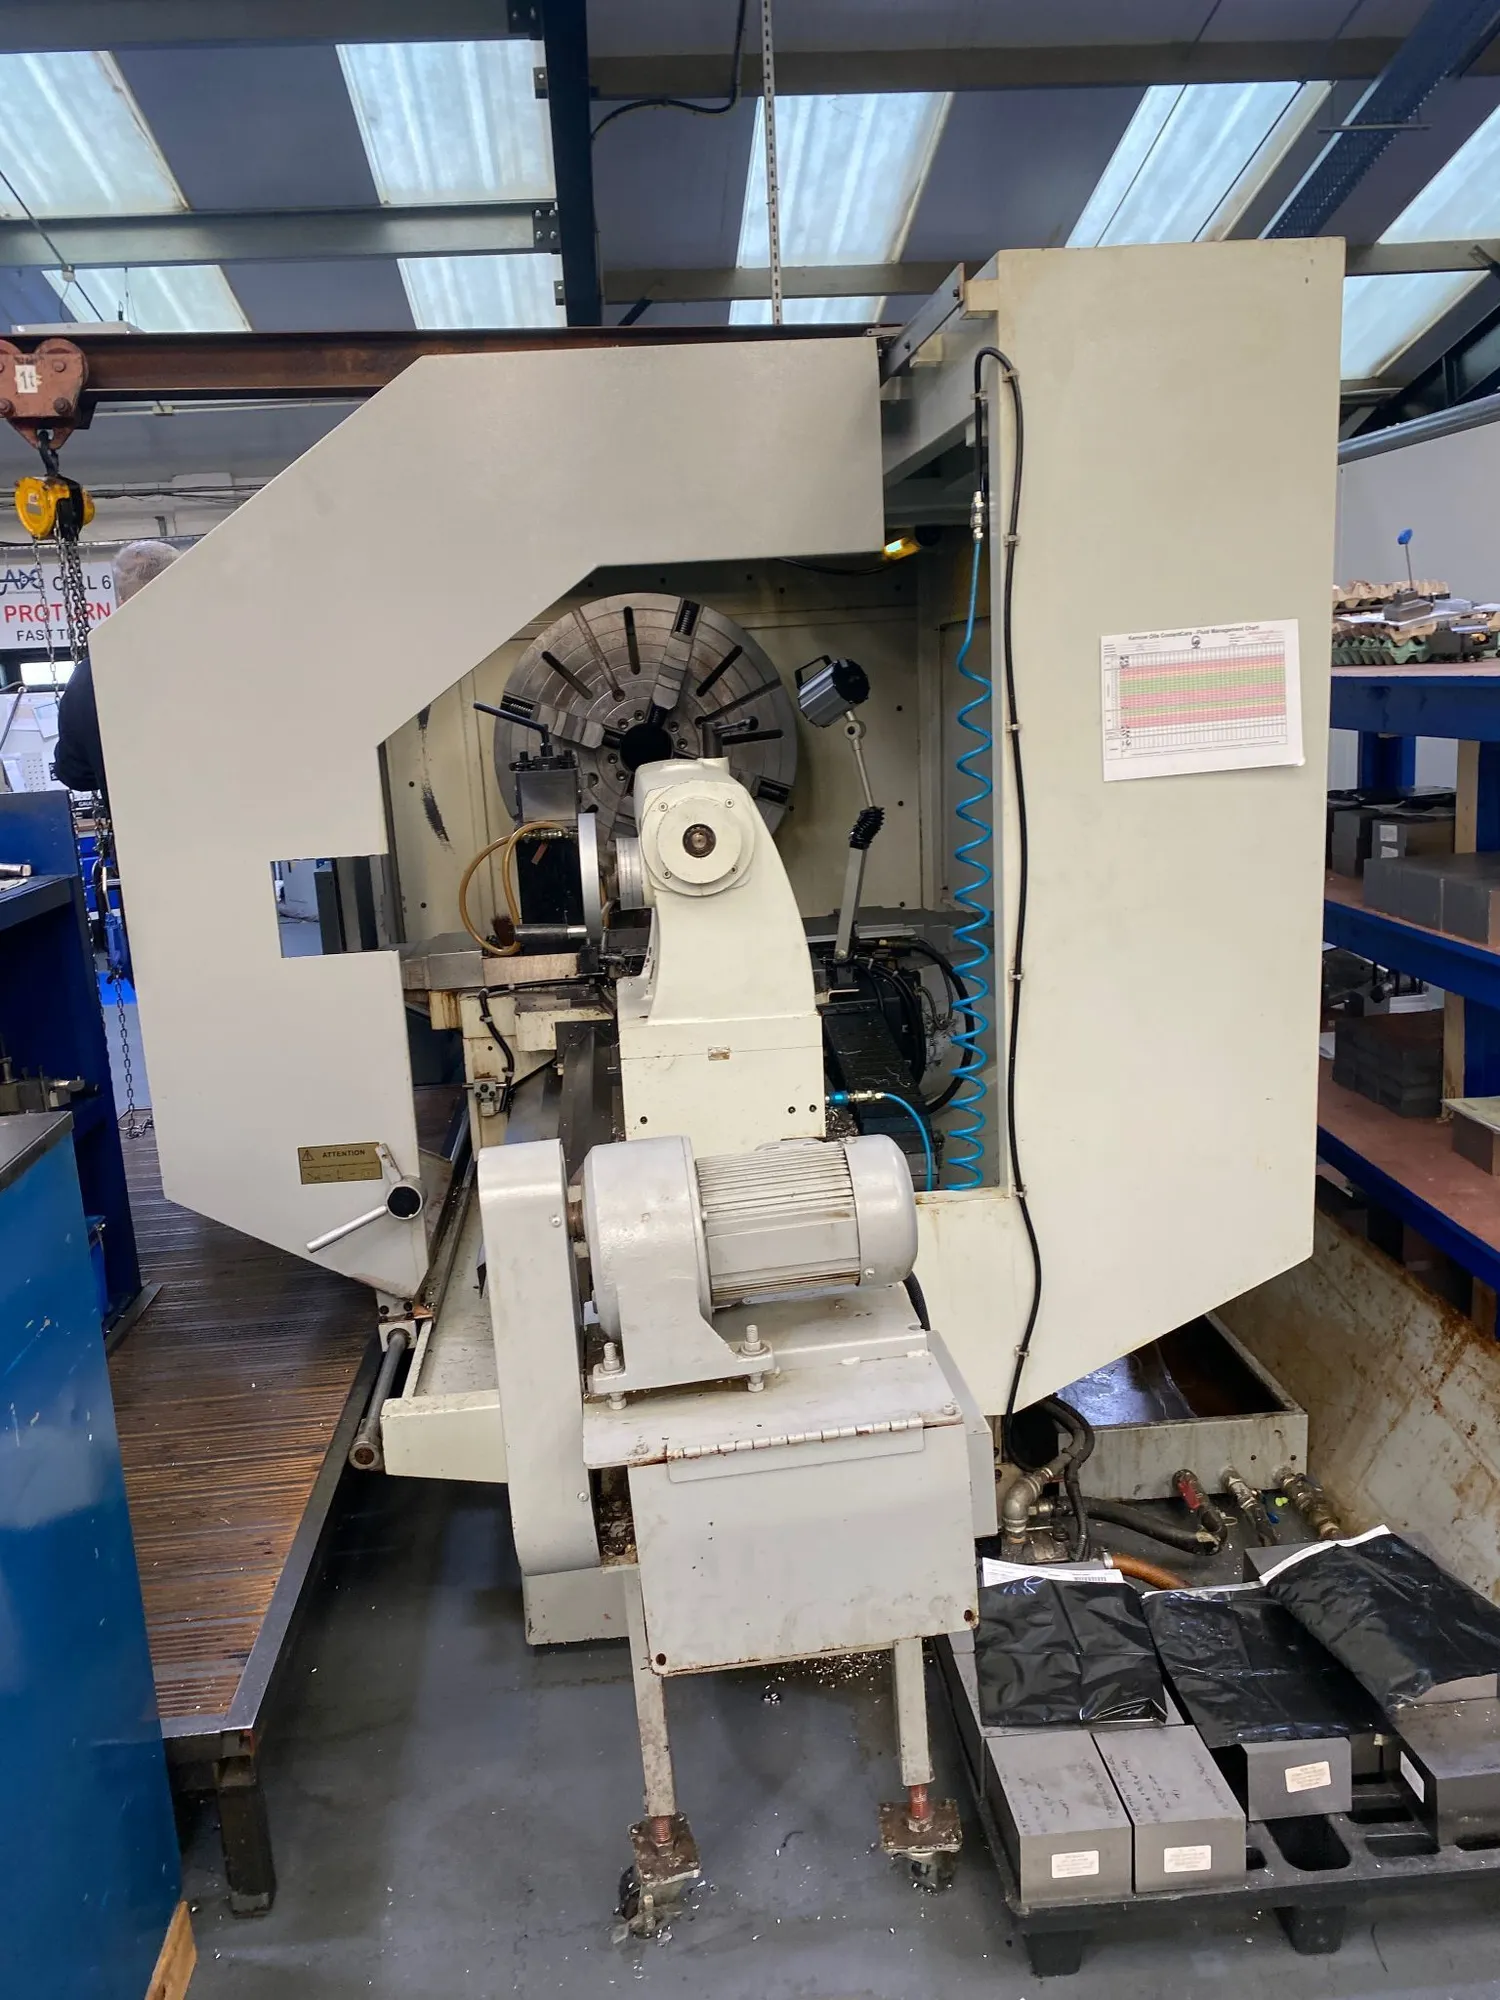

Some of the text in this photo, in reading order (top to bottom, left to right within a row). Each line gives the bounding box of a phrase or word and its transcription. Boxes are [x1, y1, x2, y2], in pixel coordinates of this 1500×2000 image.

[53, 576, 97, 590] CL
[102, 575, 111, 589] 6
[4, 602, 111, 623] PROTRN
[17, 629, 53, 642] FAST
[322, 1150, 365, 1158] ATTENTION
